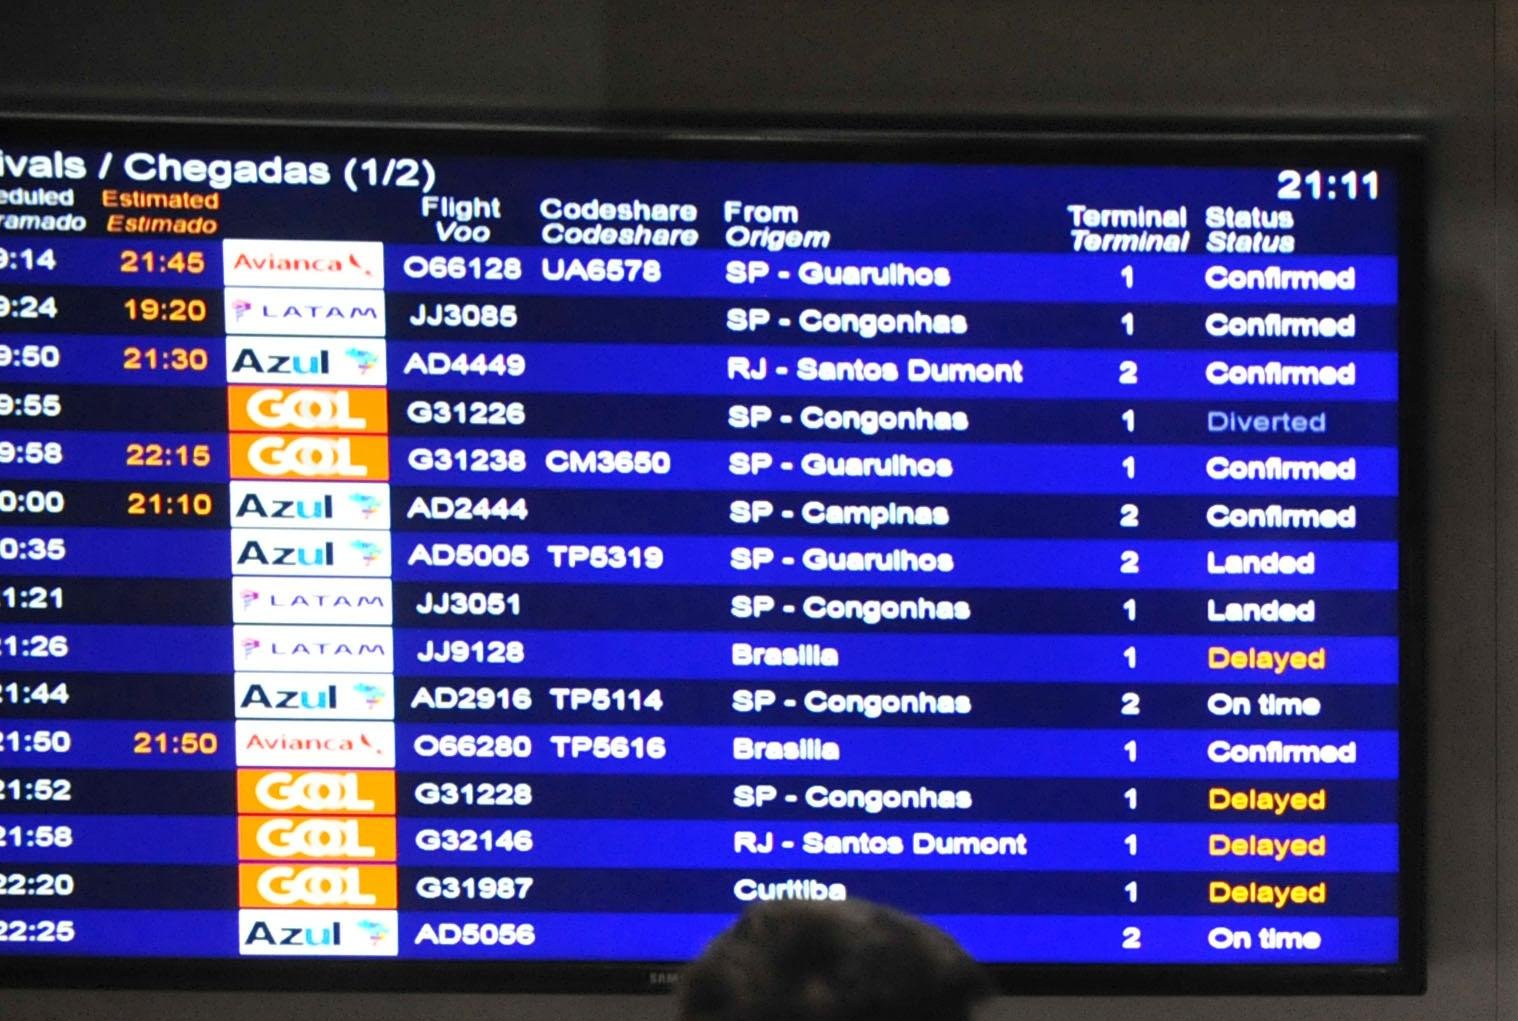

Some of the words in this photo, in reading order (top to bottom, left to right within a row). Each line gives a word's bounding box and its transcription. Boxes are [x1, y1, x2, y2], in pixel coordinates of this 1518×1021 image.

[99, 152, 112, 179] /
[124, 153, 330, 189] Chegadas
[345, 158, 435, 193] (1/2)
[1278, 170, 1378, 199] 21:11
[102, 190, 220, 209] Estimated
[420, 195, 503, 223] Flight
[540, 198, 697, 221] Codeshare
[724, 201, 798, 223] From
[1067, 205, 1187, 228] Terminal
[1206, 206, 1294, 228] Status
[107, 215, 218, 234] Estimado
[435, 220, 492, 243] Voo
[542, 223, 699, 246] Codeshare
[726, 226, 831, 251] Origem
[1071, 229, 1190, 252] Terminal
[1206, 231, 1295, 253] Status
[121, 250, 205, 274] 21:45
[233, 253, 343, 272] Avianca
[542, 258, 661, 282] UA6578
[1205, 266, 1355, 290] Confirmed
[125, 299, 206, 321] 19:20
[262, 304, 378, 320] LATAM
[410, 304, 517, 327] JJ3085
[124, 347, 208, 370] 21:30
[231, 348, 329, 375] Azul
[404, 352, 525, 376] AD4449
[727, 356, 767, 380] RJ
[797, 357, 899, 381] Santos
[908, 359, 1023, 383] Dumont
[246, 388, 367, 430] GOL
[407, 401, 525, 424] G31226
[1208, 412, 1325, 431] Diverted
[127, 444, 210, 467] 22:15
[408, 448, 526, 472] G31238
[545, 450, 670, 474] CM3650
[128, 493, 212, 515] 21:10
[408, 544, 529, 567] AD5005
[547, 545, 663, 569] TP5319
[1207, 551, 1315, 574] Landed
[417, 640, 524, 663] JJ9128
[1208, 646, 1327, 674] Delayed
[411, 687, 532, 709] AD2916
[549, 688, 663, 711] TP5114
[1208, 693, 1251, 715] On
[1258, 693, 1321, 715] time
[134, 732, 218, 754] 21:50
[550, 736, 666, 759] TP5616
[415, 783, 532, 805] G31228
[415, 829, 533, 851] G32146
[416, 877, 533, 899] G31987
[734, 879, 847, 903] Curitiba
[1209, 881, 1327, 908] Delayed
[414, 923, 535, 945] AD5056
